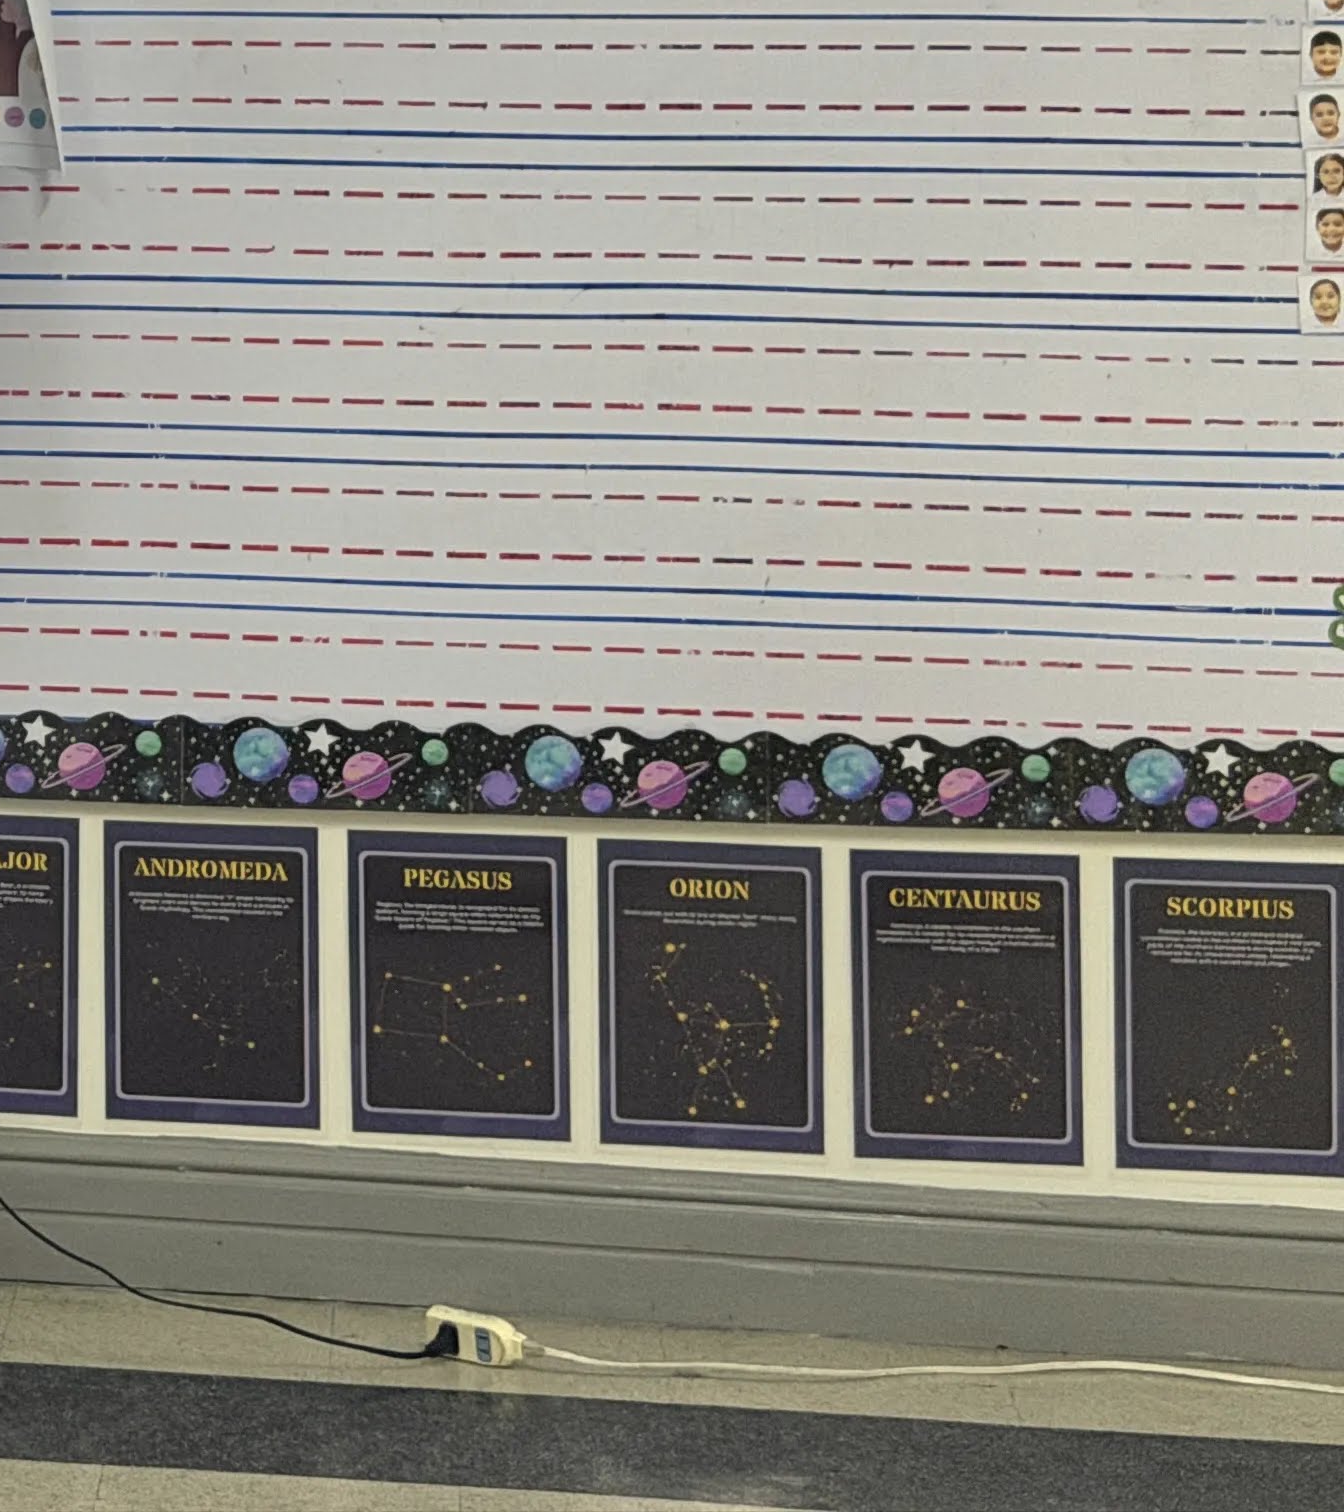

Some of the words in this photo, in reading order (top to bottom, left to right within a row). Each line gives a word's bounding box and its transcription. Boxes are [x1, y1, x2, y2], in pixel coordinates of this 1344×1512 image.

[133, 857, 289, 883] ANDROMEDA
[402, 867, 512, 891] PEGASUS
[669, 877, 750, 901] ORION
[888, 887, 1041, 911] CENTAURUS
[1166, 896, 1294, 919] SCORPIUS
